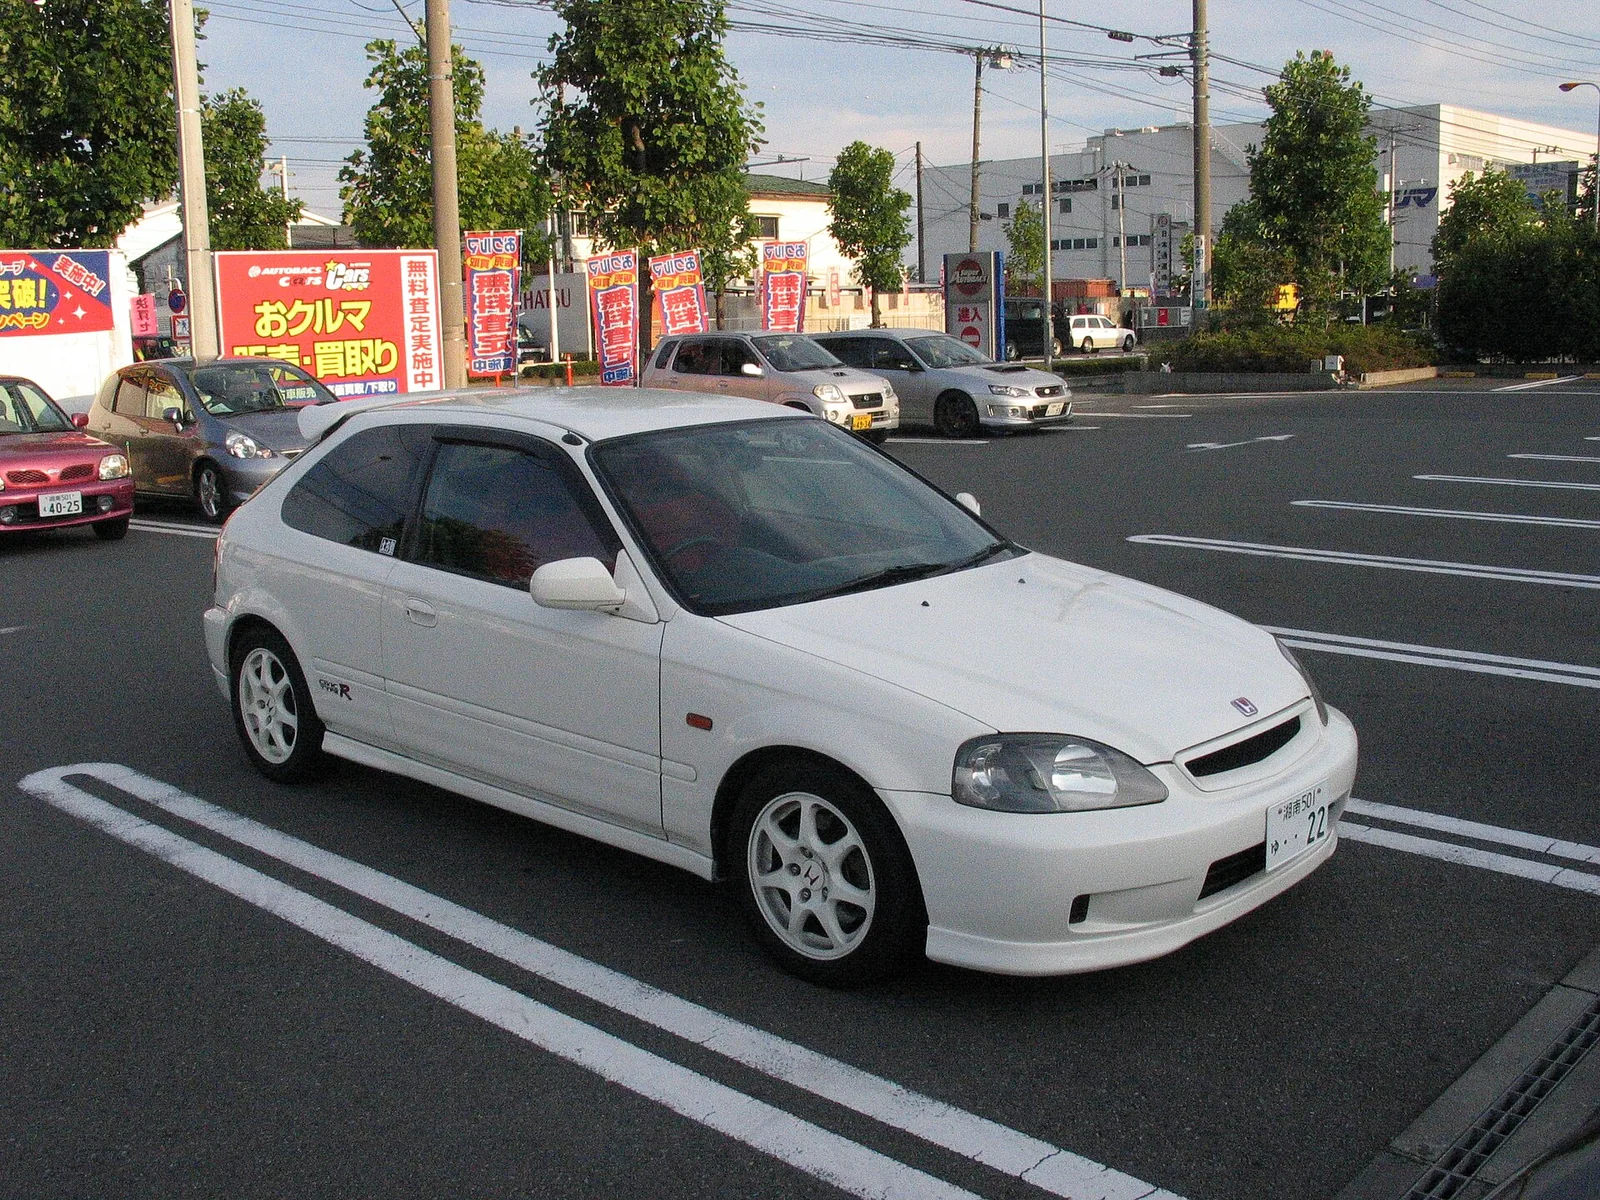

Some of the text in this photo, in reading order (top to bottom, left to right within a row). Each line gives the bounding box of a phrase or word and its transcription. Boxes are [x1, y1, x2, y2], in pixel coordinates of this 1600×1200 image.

[0, 260, 25, 275] ープ
[52, 254, 106, 297] 実施中!
[261, 267, 322, 276] AUTOBACS
[325, 262, 370, 290] Cars
[254, 299, 372, 337] おクルマ
[407, 260, 433, 388] 無料査定実施中
[958, 307, 982, 322] 進入
[49, 500, 80, 513] 40-25
